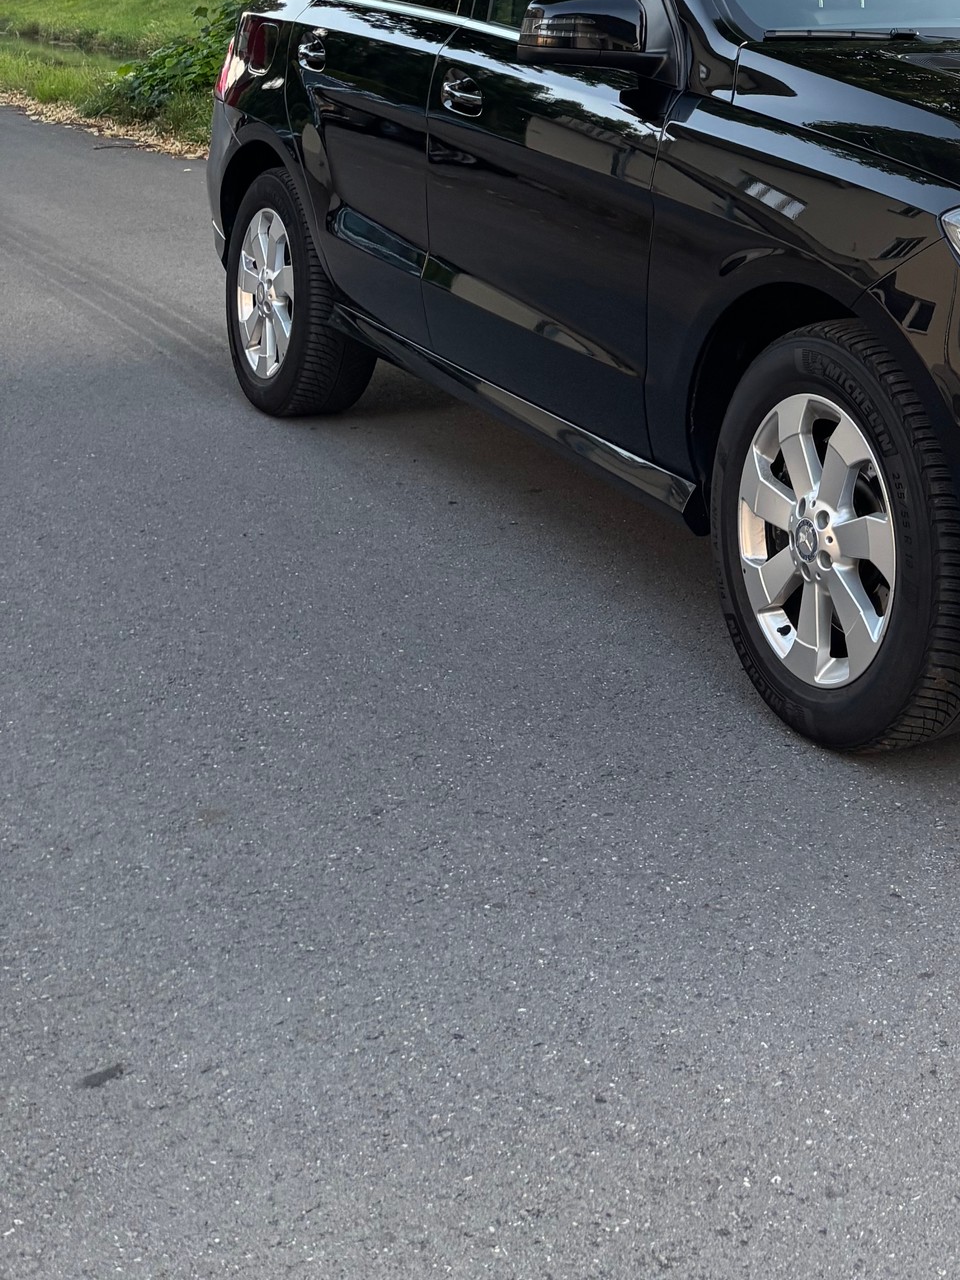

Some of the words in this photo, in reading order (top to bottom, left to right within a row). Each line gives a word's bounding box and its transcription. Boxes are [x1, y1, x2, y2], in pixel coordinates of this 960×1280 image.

[825, 363, 893, 452] MICHELIN
[892, 472, 911, 529] 255/55
[727, 619, 783, 710] MICHELIN
